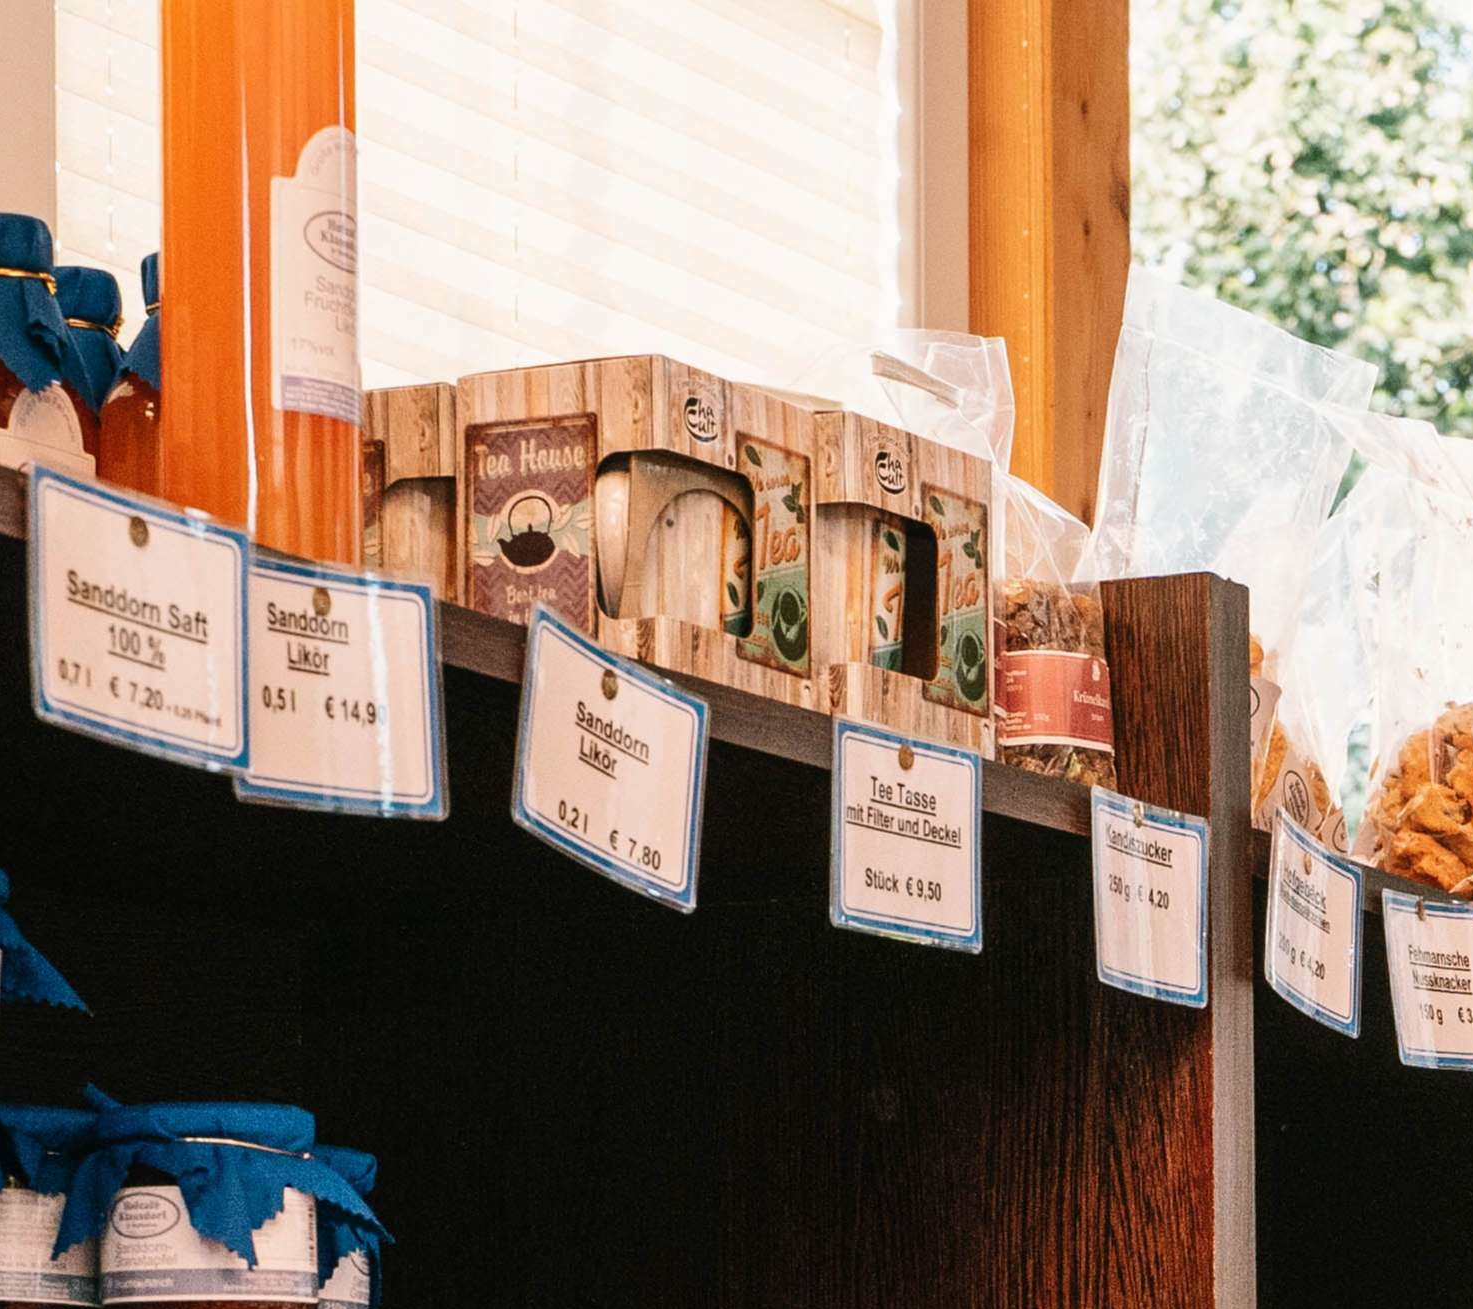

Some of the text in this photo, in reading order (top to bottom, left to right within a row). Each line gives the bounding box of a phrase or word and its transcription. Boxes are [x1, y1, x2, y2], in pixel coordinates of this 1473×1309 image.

[473, 437, 588, 481] Tea House
[755, 500, 802, 571] Tea
[505, 583, 558, 604] Best tea
[938, 549, 981, 617] Tea
[66, 569, 209, 641] Sanddorn Saft
[267, 601, 349, 640] Sanddorn
[108, 624, 167, 668] 100 %
[287, 641, 330, 671] Likör
[575, 700, 650, 758] Sanddorn
[579, 735, 618, 773] Likör
[870, 774, 937, 812] Tee Tasse
[846, 802, 962, 847] mit Filter und Deckel
[865, 867, 943, 906] Stück € 9,50
[1407, 943, 1471, 968] Fehmarnsche
[1412, 968, 1473, 992] Nussknacker
